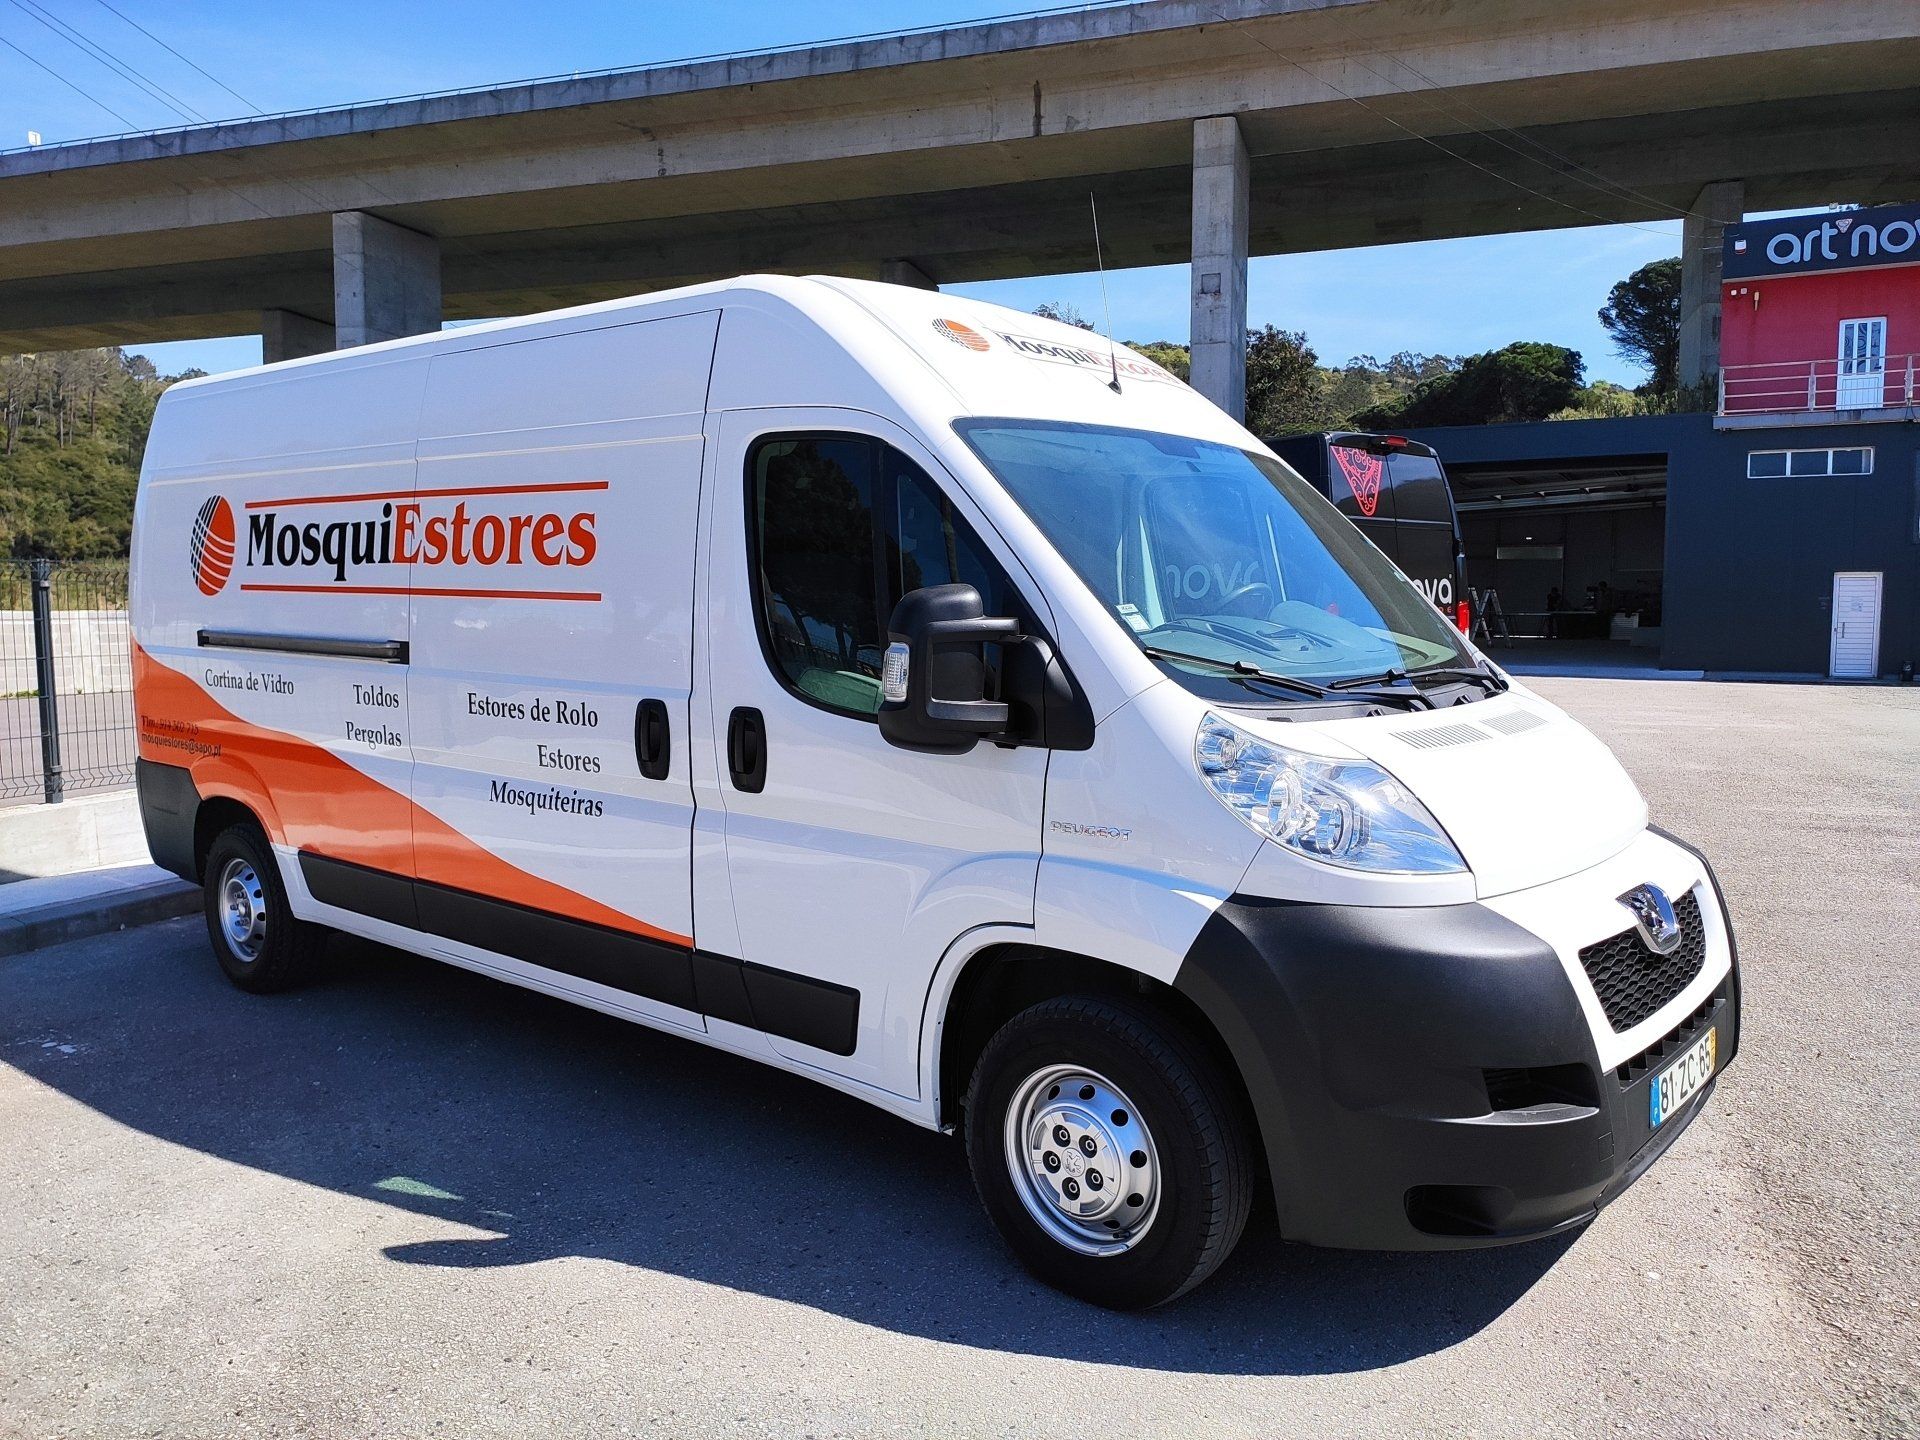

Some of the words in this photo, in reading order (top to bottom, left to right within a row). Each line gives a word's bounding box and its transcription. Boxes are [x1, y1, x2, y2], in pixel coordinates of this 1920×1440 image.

[246, 501, 597, 582] MosquiEstores
[205, 668, 243, 690] Cortina
[245, 672, 259, 691] de
[261, 673, 294, 695] Vidro
[353, 684, 399, 708] Toldos
[467, 692, 525, 720] Estores
[530, 698, 551, 723] de
[555, 700, 599, 728] Rolo
[345, 720, 402, 750] Pergolas
[536, 744, 601, 773] Estores
[489, 779, 603, 818] Mosquiteiras
[1050, 820, 1132, 841] PEUGEOT
